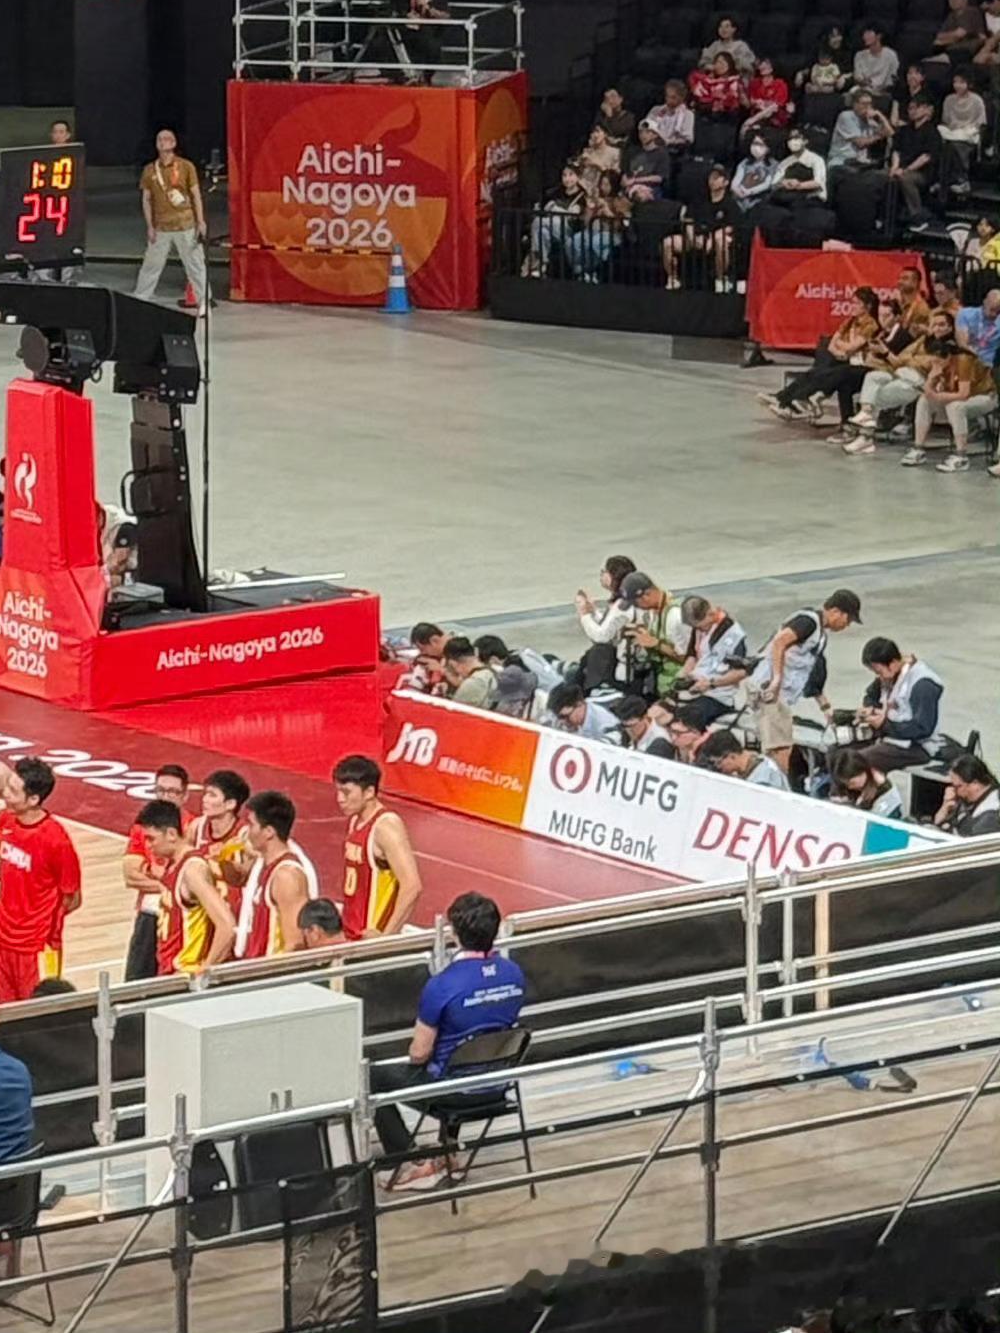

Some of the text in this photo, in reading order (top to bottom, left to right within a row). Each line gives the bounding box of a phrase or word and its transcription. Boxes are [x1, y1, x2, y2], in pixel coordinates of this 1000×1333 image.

[297, 142, 401, 175] Aichi-
[282, 176, 416, 215] Nagoya
[18, 194, 67, 241] 24
[306, 217, 393, 247] 2026
[4, 591, 52, 621] Aichi-
[7, 647, 48, 678] 2026
[156, 626, 324, 670] Aichi-Nagoya 2026
[385, 722, 438, 766] JTB
[595, 761, 679, 813] MUFG
[548, 809, 658, 862] MUFG Bank
